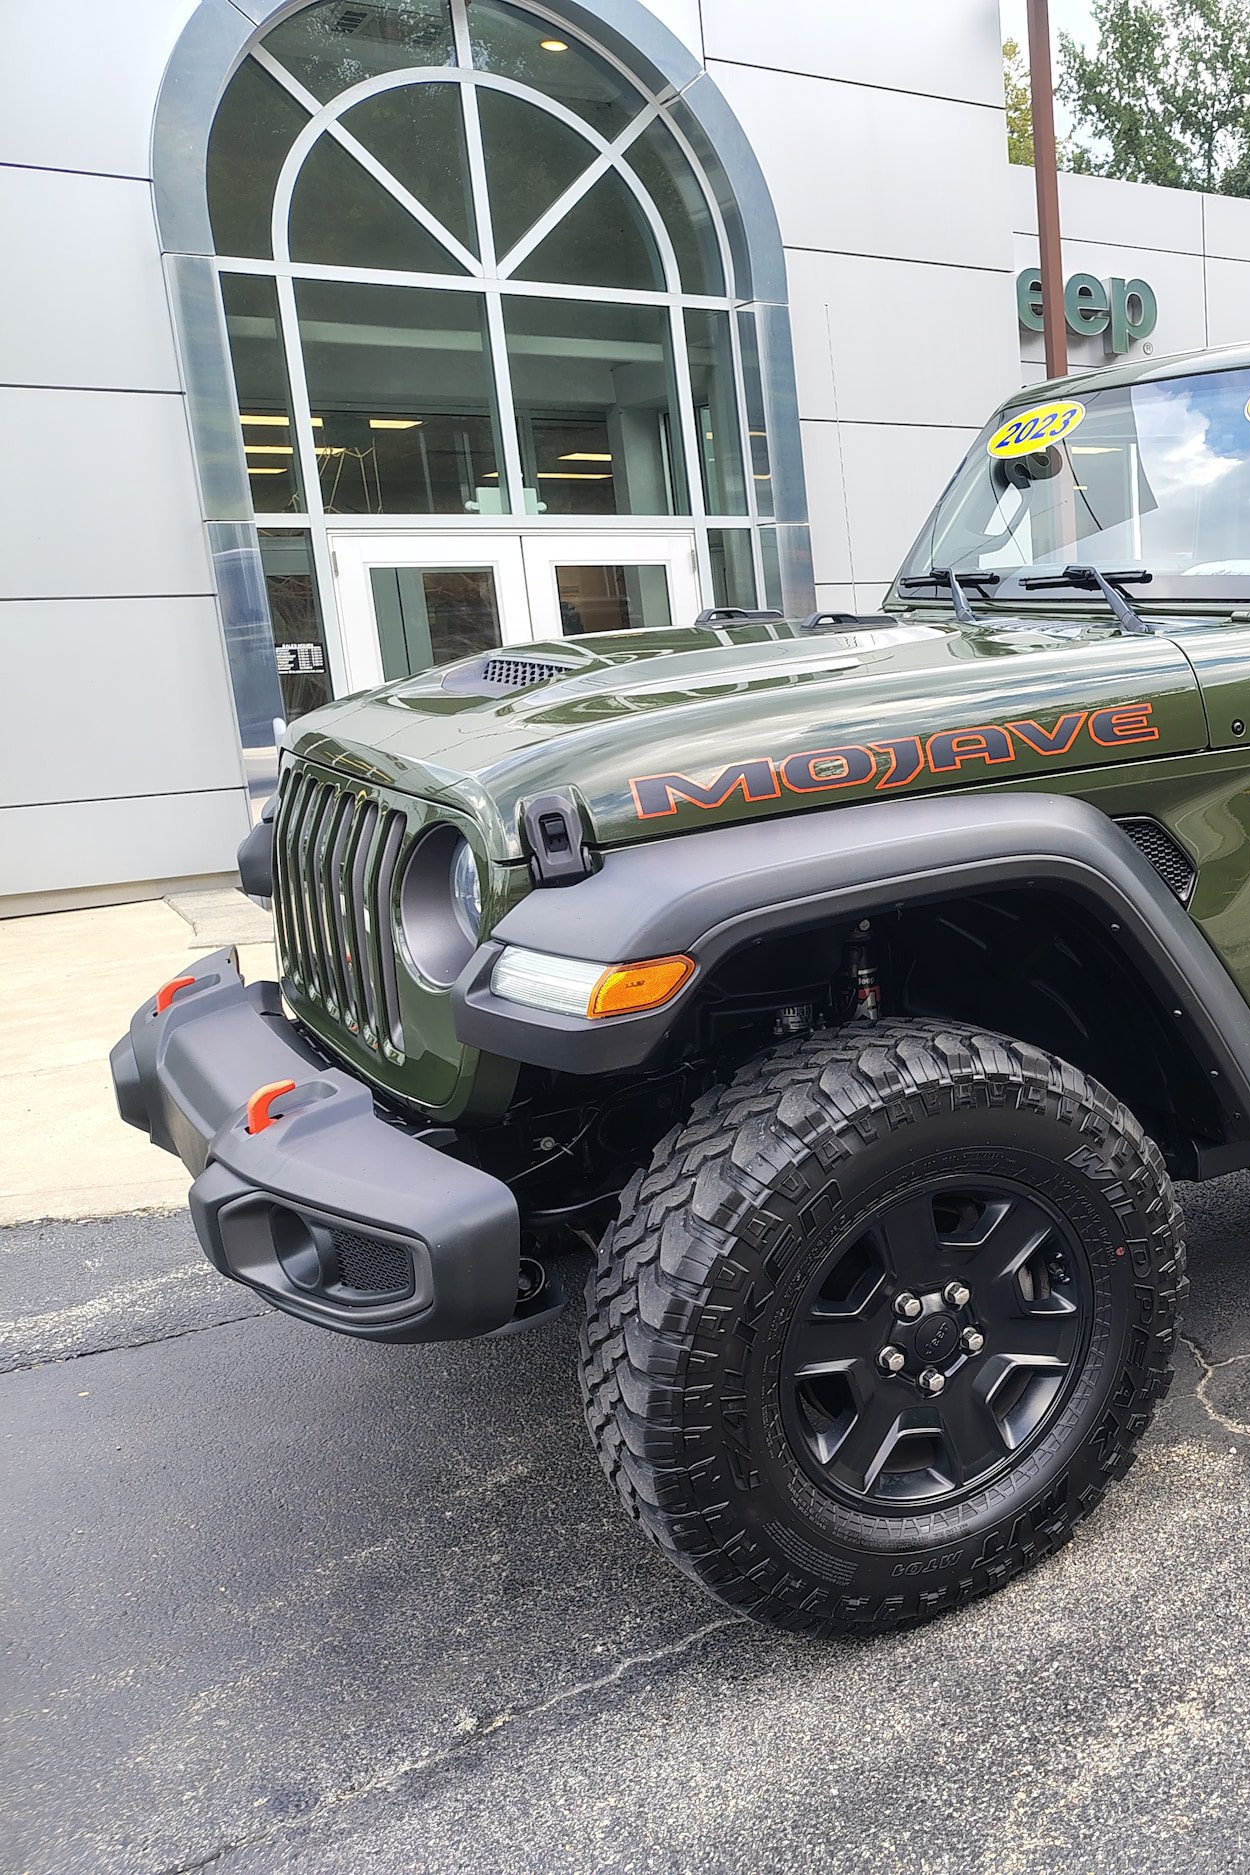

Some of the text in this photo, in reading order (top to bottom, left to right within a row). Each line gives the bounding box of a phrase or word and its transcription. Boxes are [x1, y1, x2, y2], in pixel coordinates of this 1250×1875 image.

[994, 408, 1077, 449] 2023
[627, 703, 1160, 820] MOJAVE
[1064, 1143, 1155, 1465] WILDPEAK
[890, 1549, 965, 1578] MT01
